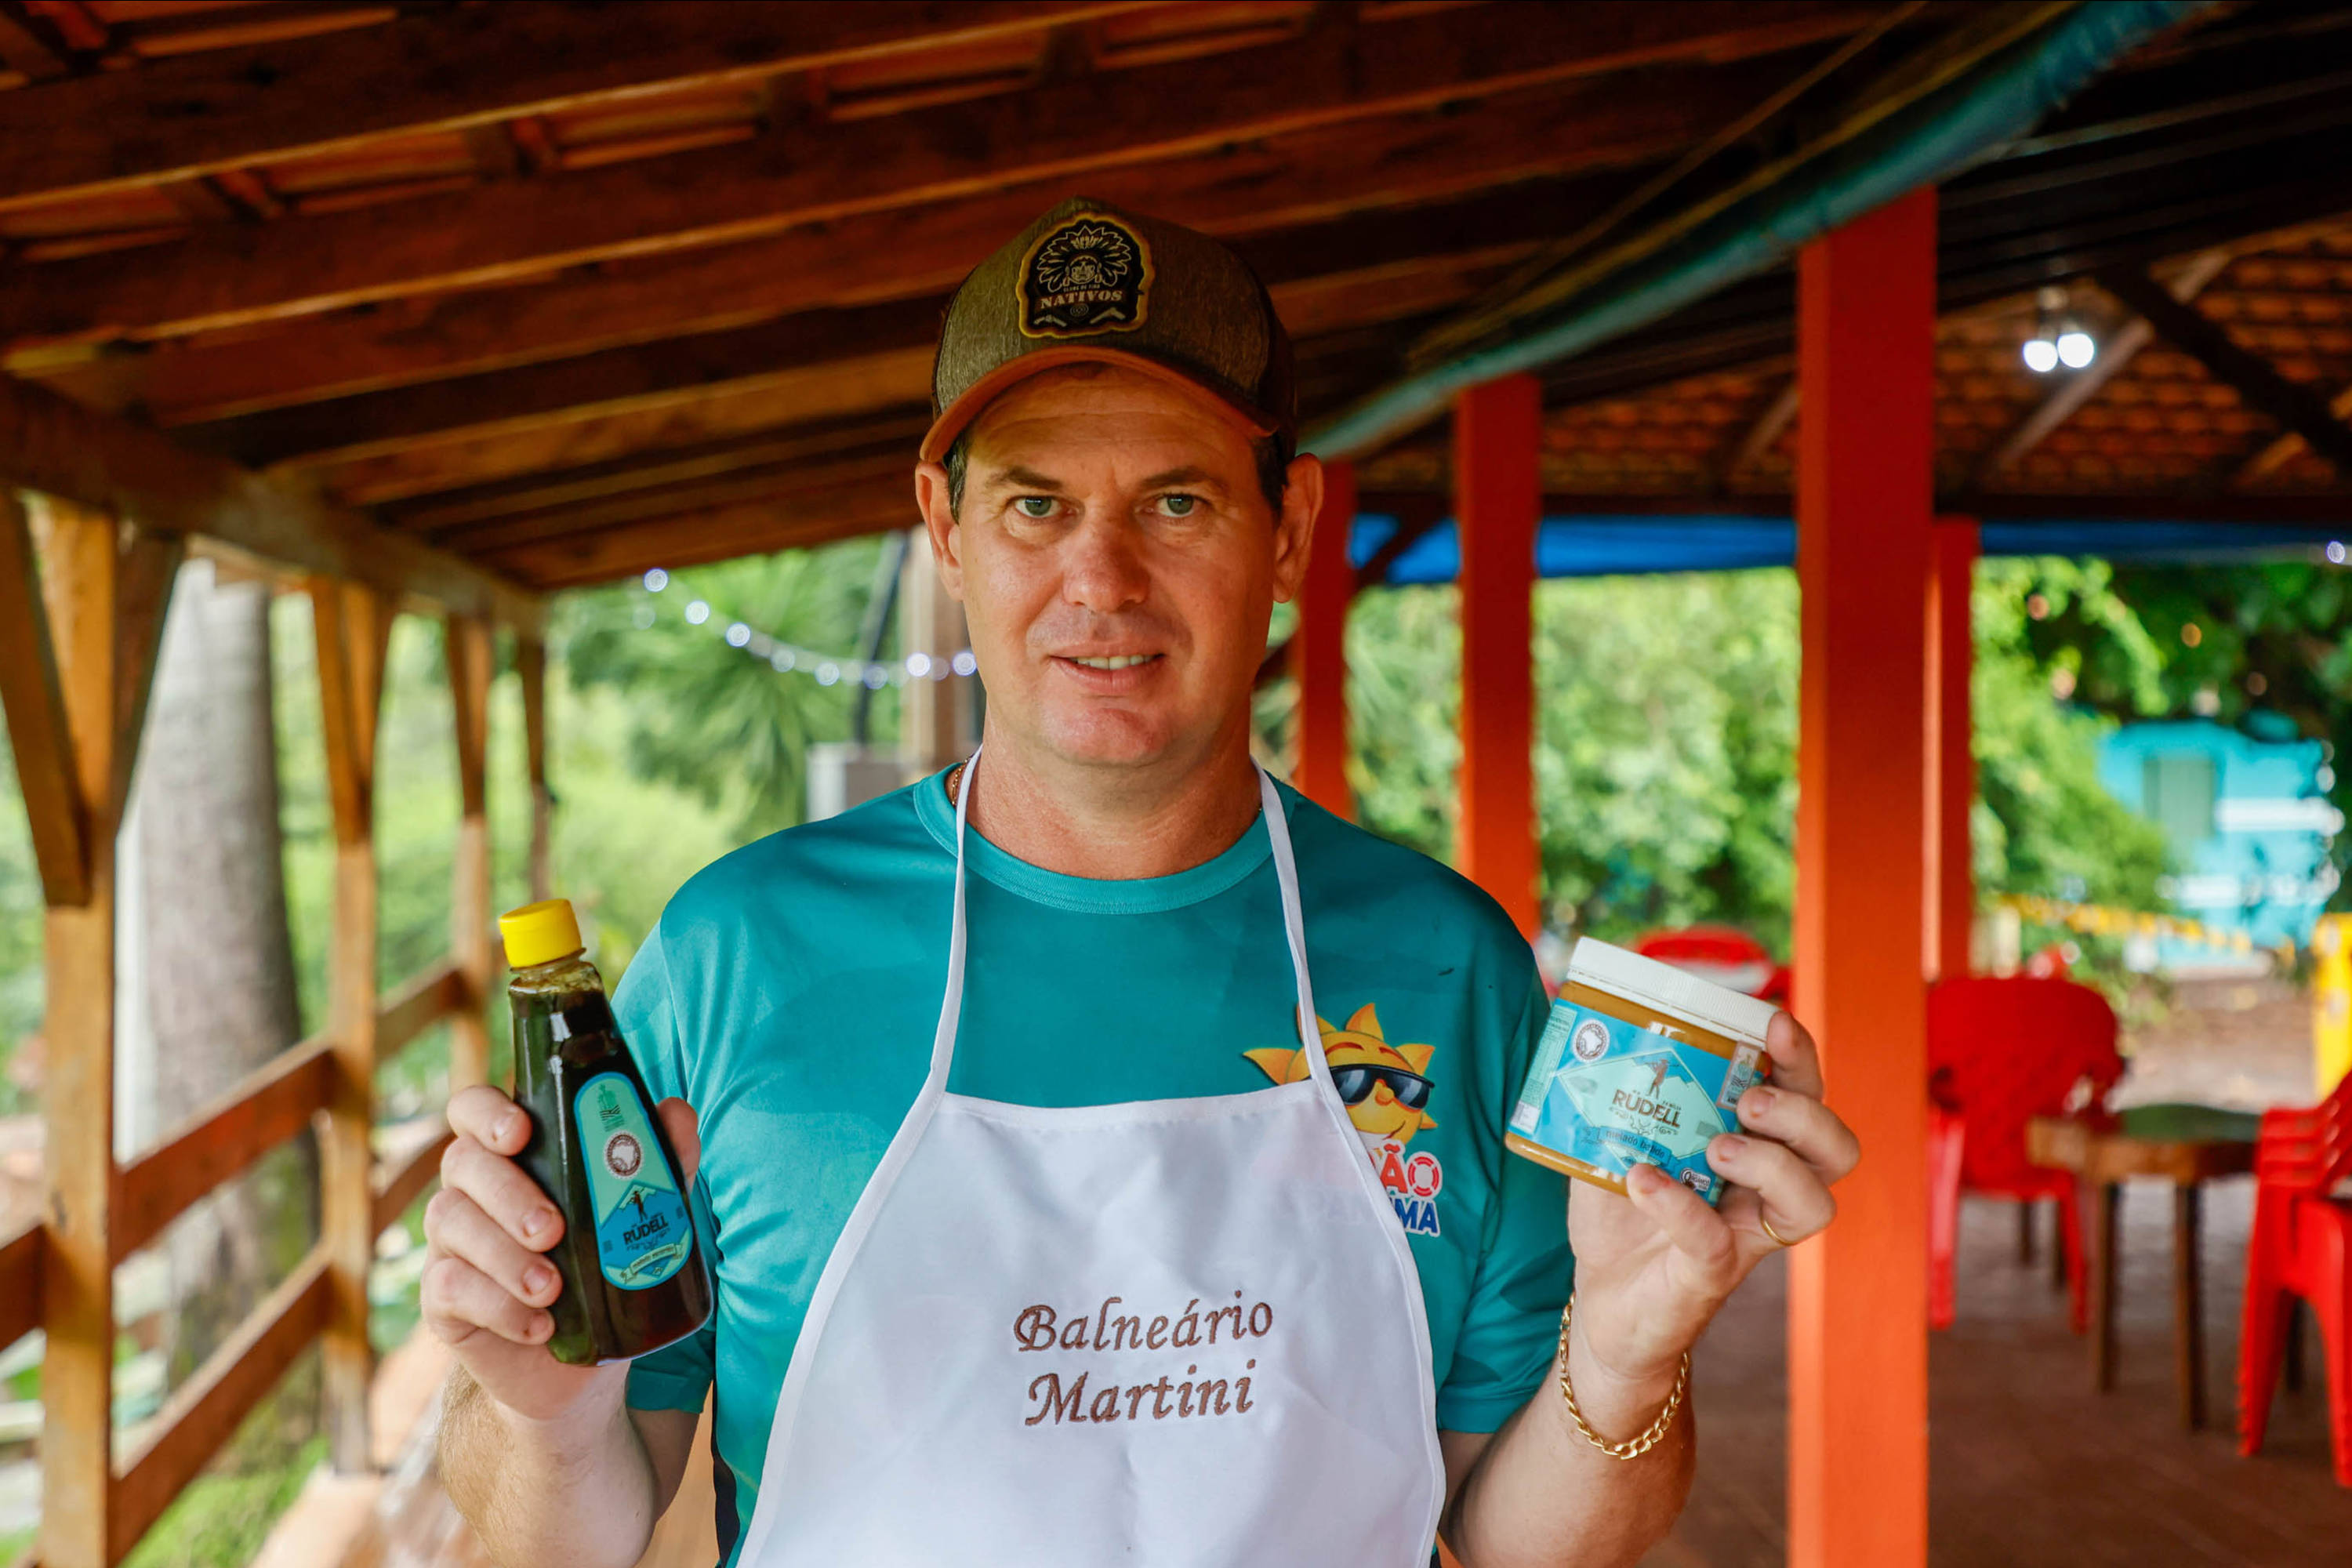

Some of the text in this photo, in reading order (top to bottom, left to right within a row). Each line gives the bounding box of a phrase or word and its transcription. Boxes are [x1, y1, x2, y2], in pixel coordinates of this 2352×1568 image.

[1040, 290, 1123, 309] NATIVOS
[1612, 1088, 1680, 1128] RÜDELL
[1014, 1290, 1273, 1352] Balneário
[1025, 1359, 1256, 1425] Martini
